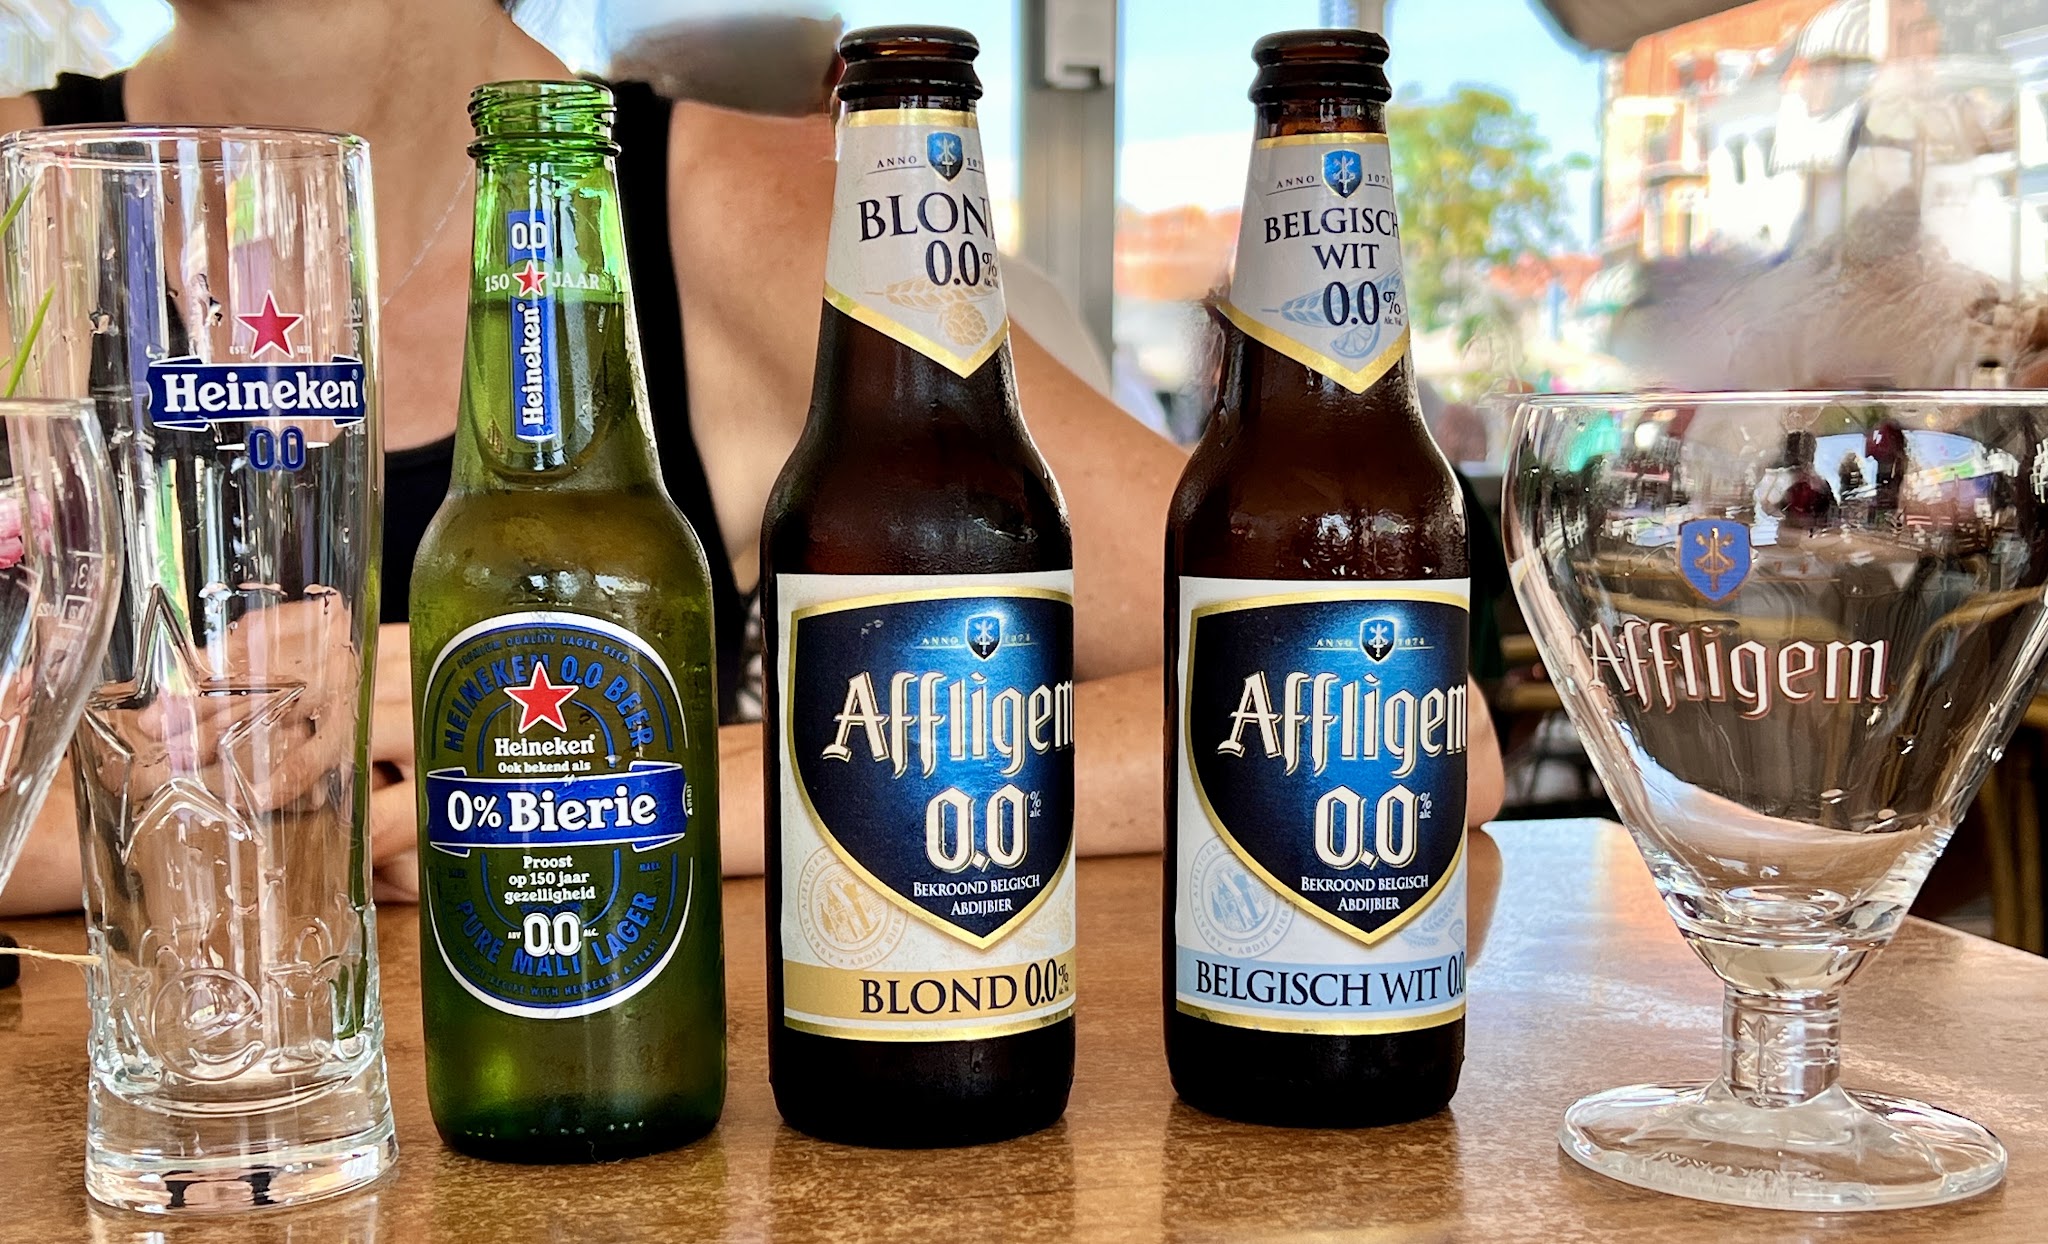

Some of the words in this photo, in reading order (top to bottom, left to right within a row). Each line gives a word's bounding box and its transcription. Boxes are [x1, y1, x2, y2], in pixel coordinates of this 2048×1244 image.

[876, 155, 917, 169] ANNO
[967, 157, 984, 169] 107
[1276, 175, 1315, 189] ANNO
[857, 192, 997, 244] BLON
[511, 221, 547, 250] 0.0
[1312, 244, 1380, 269] WIT
[485, 274, 510, 292] 150
[552, 272, 599, 288] JAAR
[520, 305, 544, 426] Heineken
[162, 372, 358, 412] Heineken
[248, 426, 306, 472] 0.0
[506, 633, 557, 647] QUALITY
[562, 635, 599, 651] LAGER
[602, 646, 630, 665] BEER
[922, 637, 960, 646] ANNO
[1315, 638, 1353, 648] ANNO
[1581, 617, 1892, 720] Affligem
[444, 653, 550, 752] HEINEKEN
[560, 655, 605, 689] 0.0
[604, 675, 655, 748] BEER
[821, 670, 1074, 779] Affligem
[1217, 670, 1467, 778] Affligem
[494, 736, 595, 757] Heineken
[498, 762, 522, 774] Ook
[524, 761, 570, 773] bekend
[572, 760, 591, 772] als
[447, 789, 502, 831] 0%
[507, 785, 656, 833] Bierie
[1029, 808, 1042, 818] alc
[1419, 809, 1432, 820] alc
[523, 855, 573, 870] Proost
[508, 874, 527, 888] op
[530, 872, 556, 886] 150
[557, 870, 590, 887] jaar
[913, 880, 987, 897] BEKROOND
[990, 874, 1040, 893] BELGISCH
[1301, 875, 1375, 893] BEKROOND
[1378, 874, 1429, 890] BELGISCH
[504, 886, 596, 905] gezelligheid
[950, 897, 1013, 918] ABDIJBIER
[1337, 897, 1401, 914] ABDIJBIER
[457, 900, 505, 965] PURE
[591, 892, 658, 966] LAGER
[523, 911, 582, 958] 0.0
[530, 986, 560, 997] WITH
[564, 972, 620, 996] HEINEKEN
[859, 975, 1018, 1016] BLOND
[1195, 959, 1371, 1007] BELGISCH
[1379, 966, 1442, 1005] WIT
